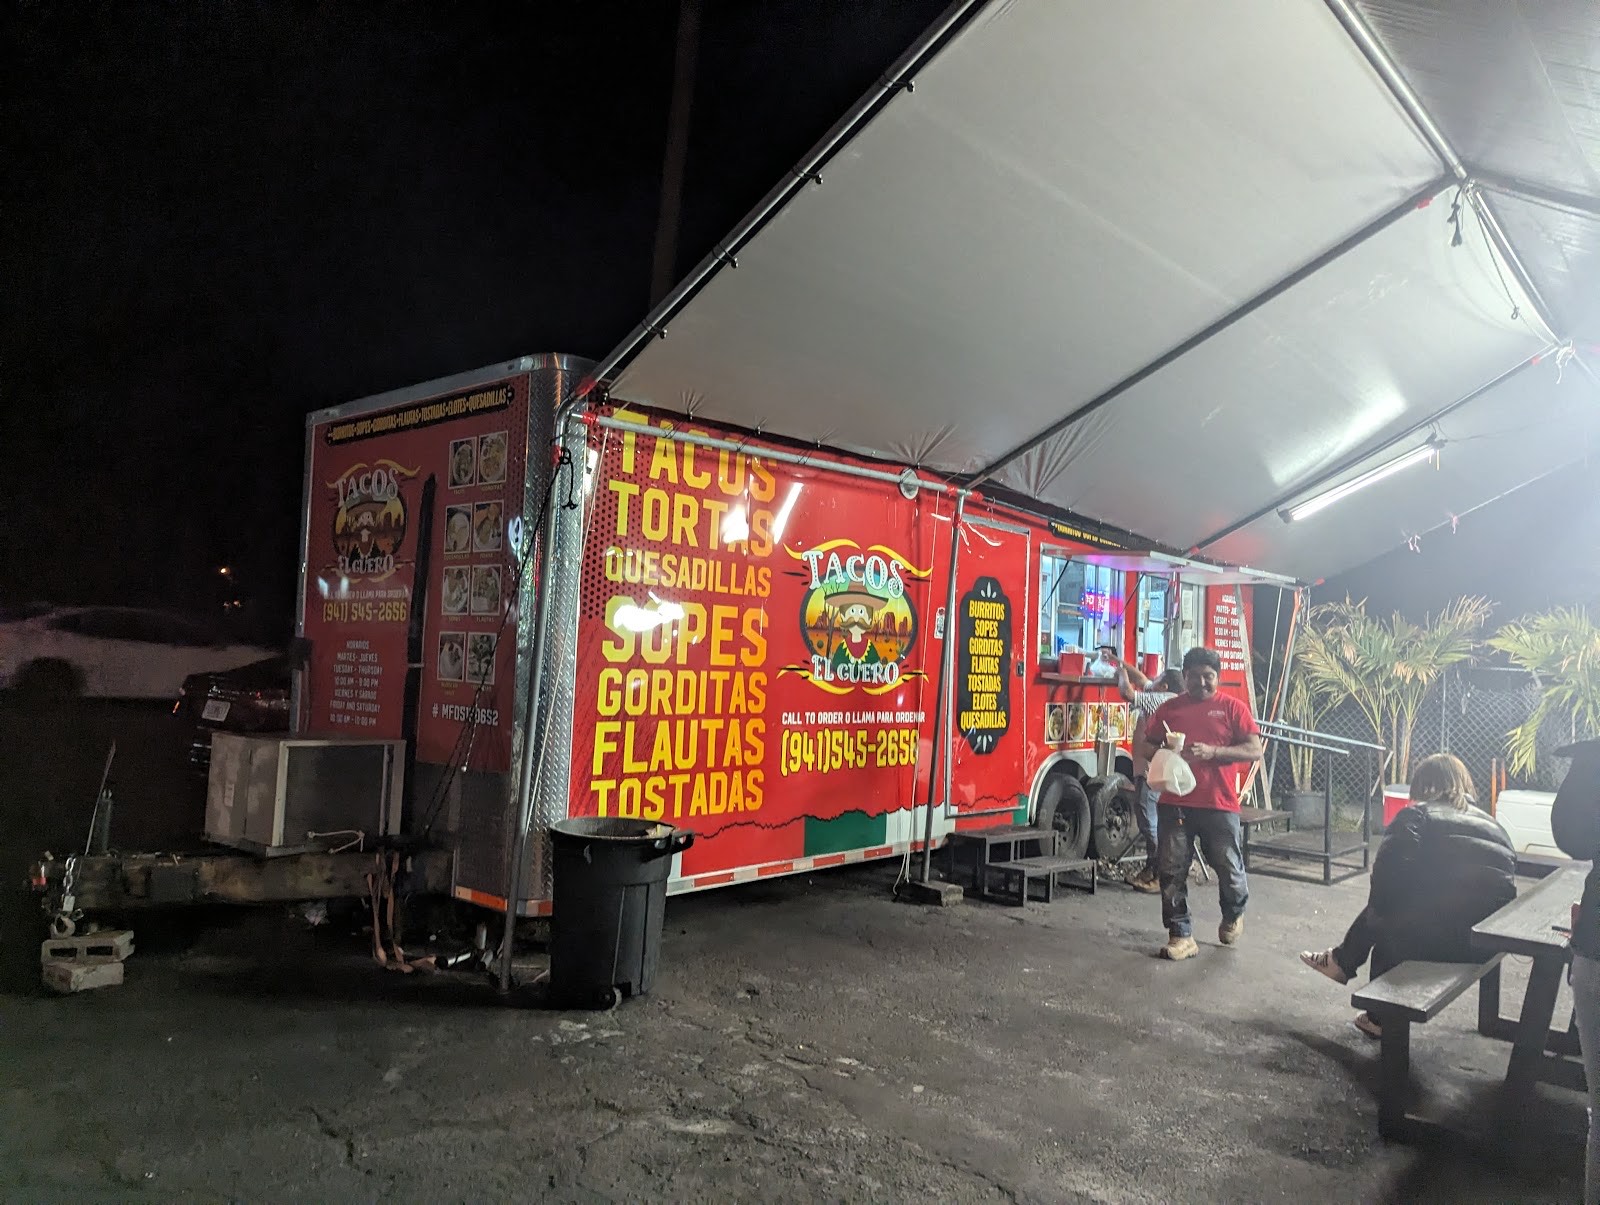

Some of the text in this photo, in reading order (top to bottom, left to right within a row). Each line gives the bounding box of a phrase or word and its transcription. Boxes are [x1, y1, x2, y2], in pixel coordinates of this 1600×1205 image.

[421, 402, 446, 422] TOSTADAS
[447, 397, 467, 416] ELOTES
[468, 387, 507, 413] QUESADILLAS
[612, 407, 777, 503] TACOS
[336, 467, 399, 508] TACOS
[605, 546, 772, 598] QUESADILLAS
[801, 550, 904, 599] TACOS
[323, 601, 408, 624] (941) 545-2656
[969, 599, 1005, 620] BURRITOS
[602, 594, 769, 668] SOPES
[975, 619, 999, 638] SOPES
[969, 637, 1003, 656] GORDITAS
[359, 653, 378, 663] JUEVES
[812, 654, 834, 682] EL
[971, 656, 1000, 674] FLAUTAS
[333, 664, 354, 674] TUESDAY
[358, 664, 383, 675] THURSDAY
[370, 678, 379, 688] PM
[597, 667, 768, 717] GORDITAS
[967, 673, 1001, 692] TOSTADAS
[346, 701, 356, 711] AND
[356, 702, 381, 713] SATURDAY
[972, 693, 997, 710] ELOTES
[368, 717, 377, 726] PM
[441, 703, 499, 727] MFDS10652
[782, 711, 803, 725] CALL
[805, 711, 816, 725] TO
[817, 711, 844, 725] ORDER
[845, 711, 851, 724] O
[852, 711, 876, 724] LLAMA
[876, 711, 894, 723] PARA
[960, 711, 1007, 732] QUESADILLAS
[592, 718, 766, 776] FLAUTAS
[590, 768, 766, 821] TOSTADAS
